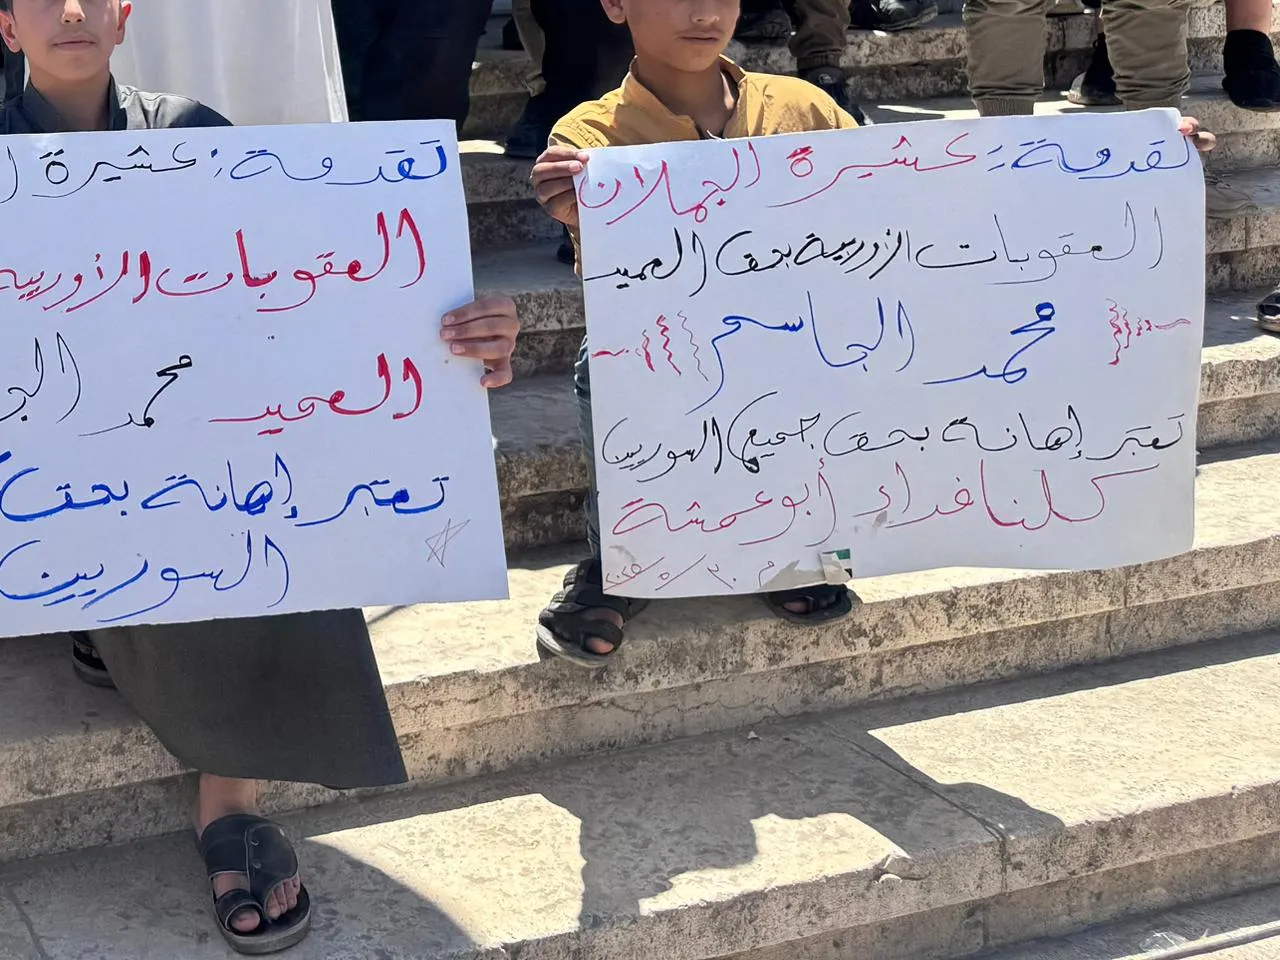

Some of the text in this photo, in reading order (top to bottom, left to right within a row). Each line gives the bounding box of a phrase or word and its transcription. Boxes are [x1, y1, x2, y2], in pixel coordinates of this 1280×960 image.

[31, 141, 197, 198] عشيرة
[767, 131, 977, 208] عشيرة
[155, 207, 426, 313] العقوبات
[584, 226, 707, 298] العميد
[715, 230, 792, 276] بحق
[915, 200, 1164, 286] العقوبات
[685, 290, 1056, 416] محمد الجاسم
[77, 355, 193, 437] محمد
[823, 411, 929, 457] بحق
[942, 404, 1083, 460] إهانة
[141, 452, 299, 520] إهانة
[294, 476, 449, 528] تعتبر
